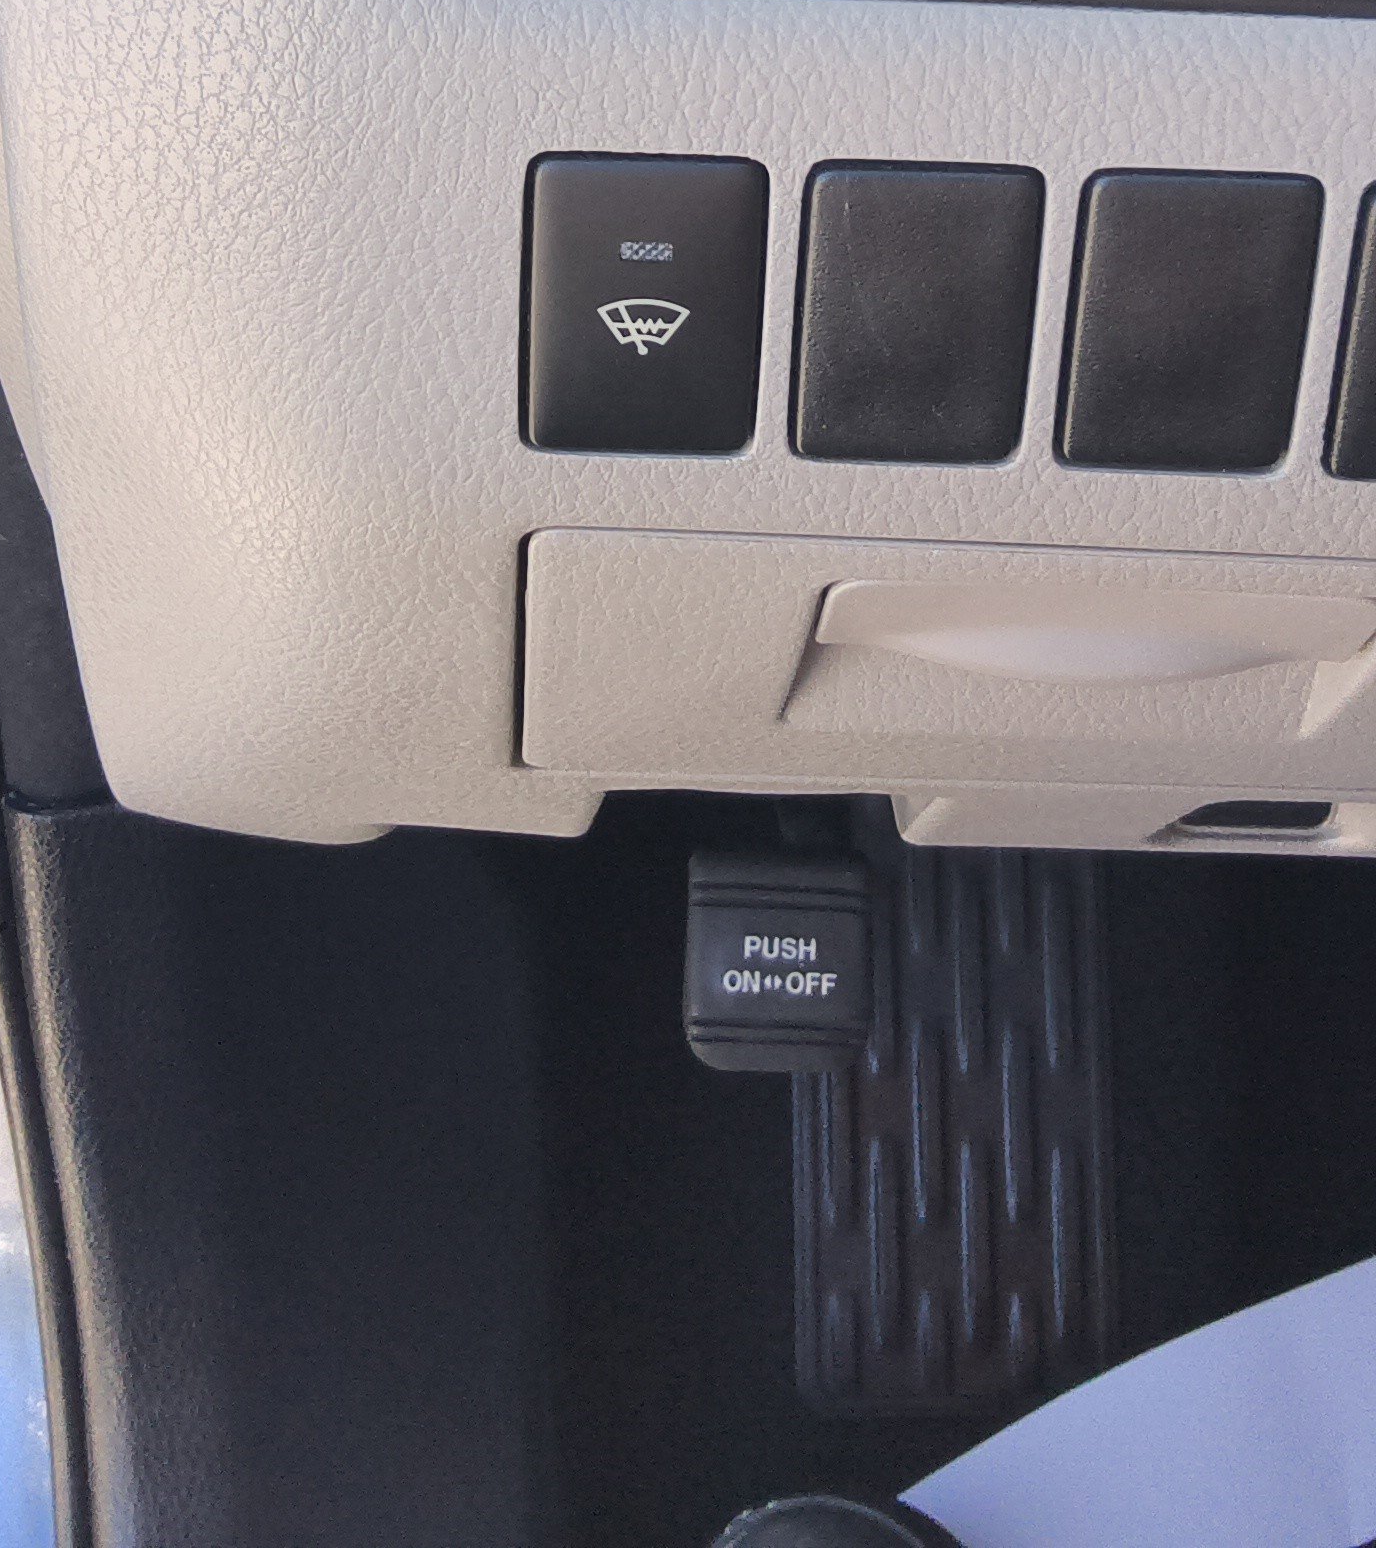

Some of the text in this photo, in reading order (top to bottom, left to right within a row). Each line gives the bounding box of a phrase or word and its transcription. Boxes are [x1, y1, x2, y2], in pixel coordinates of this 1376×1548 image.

[744, 935, 818, 962] PUSH
[724, 969, 838, 997] ON OFF
